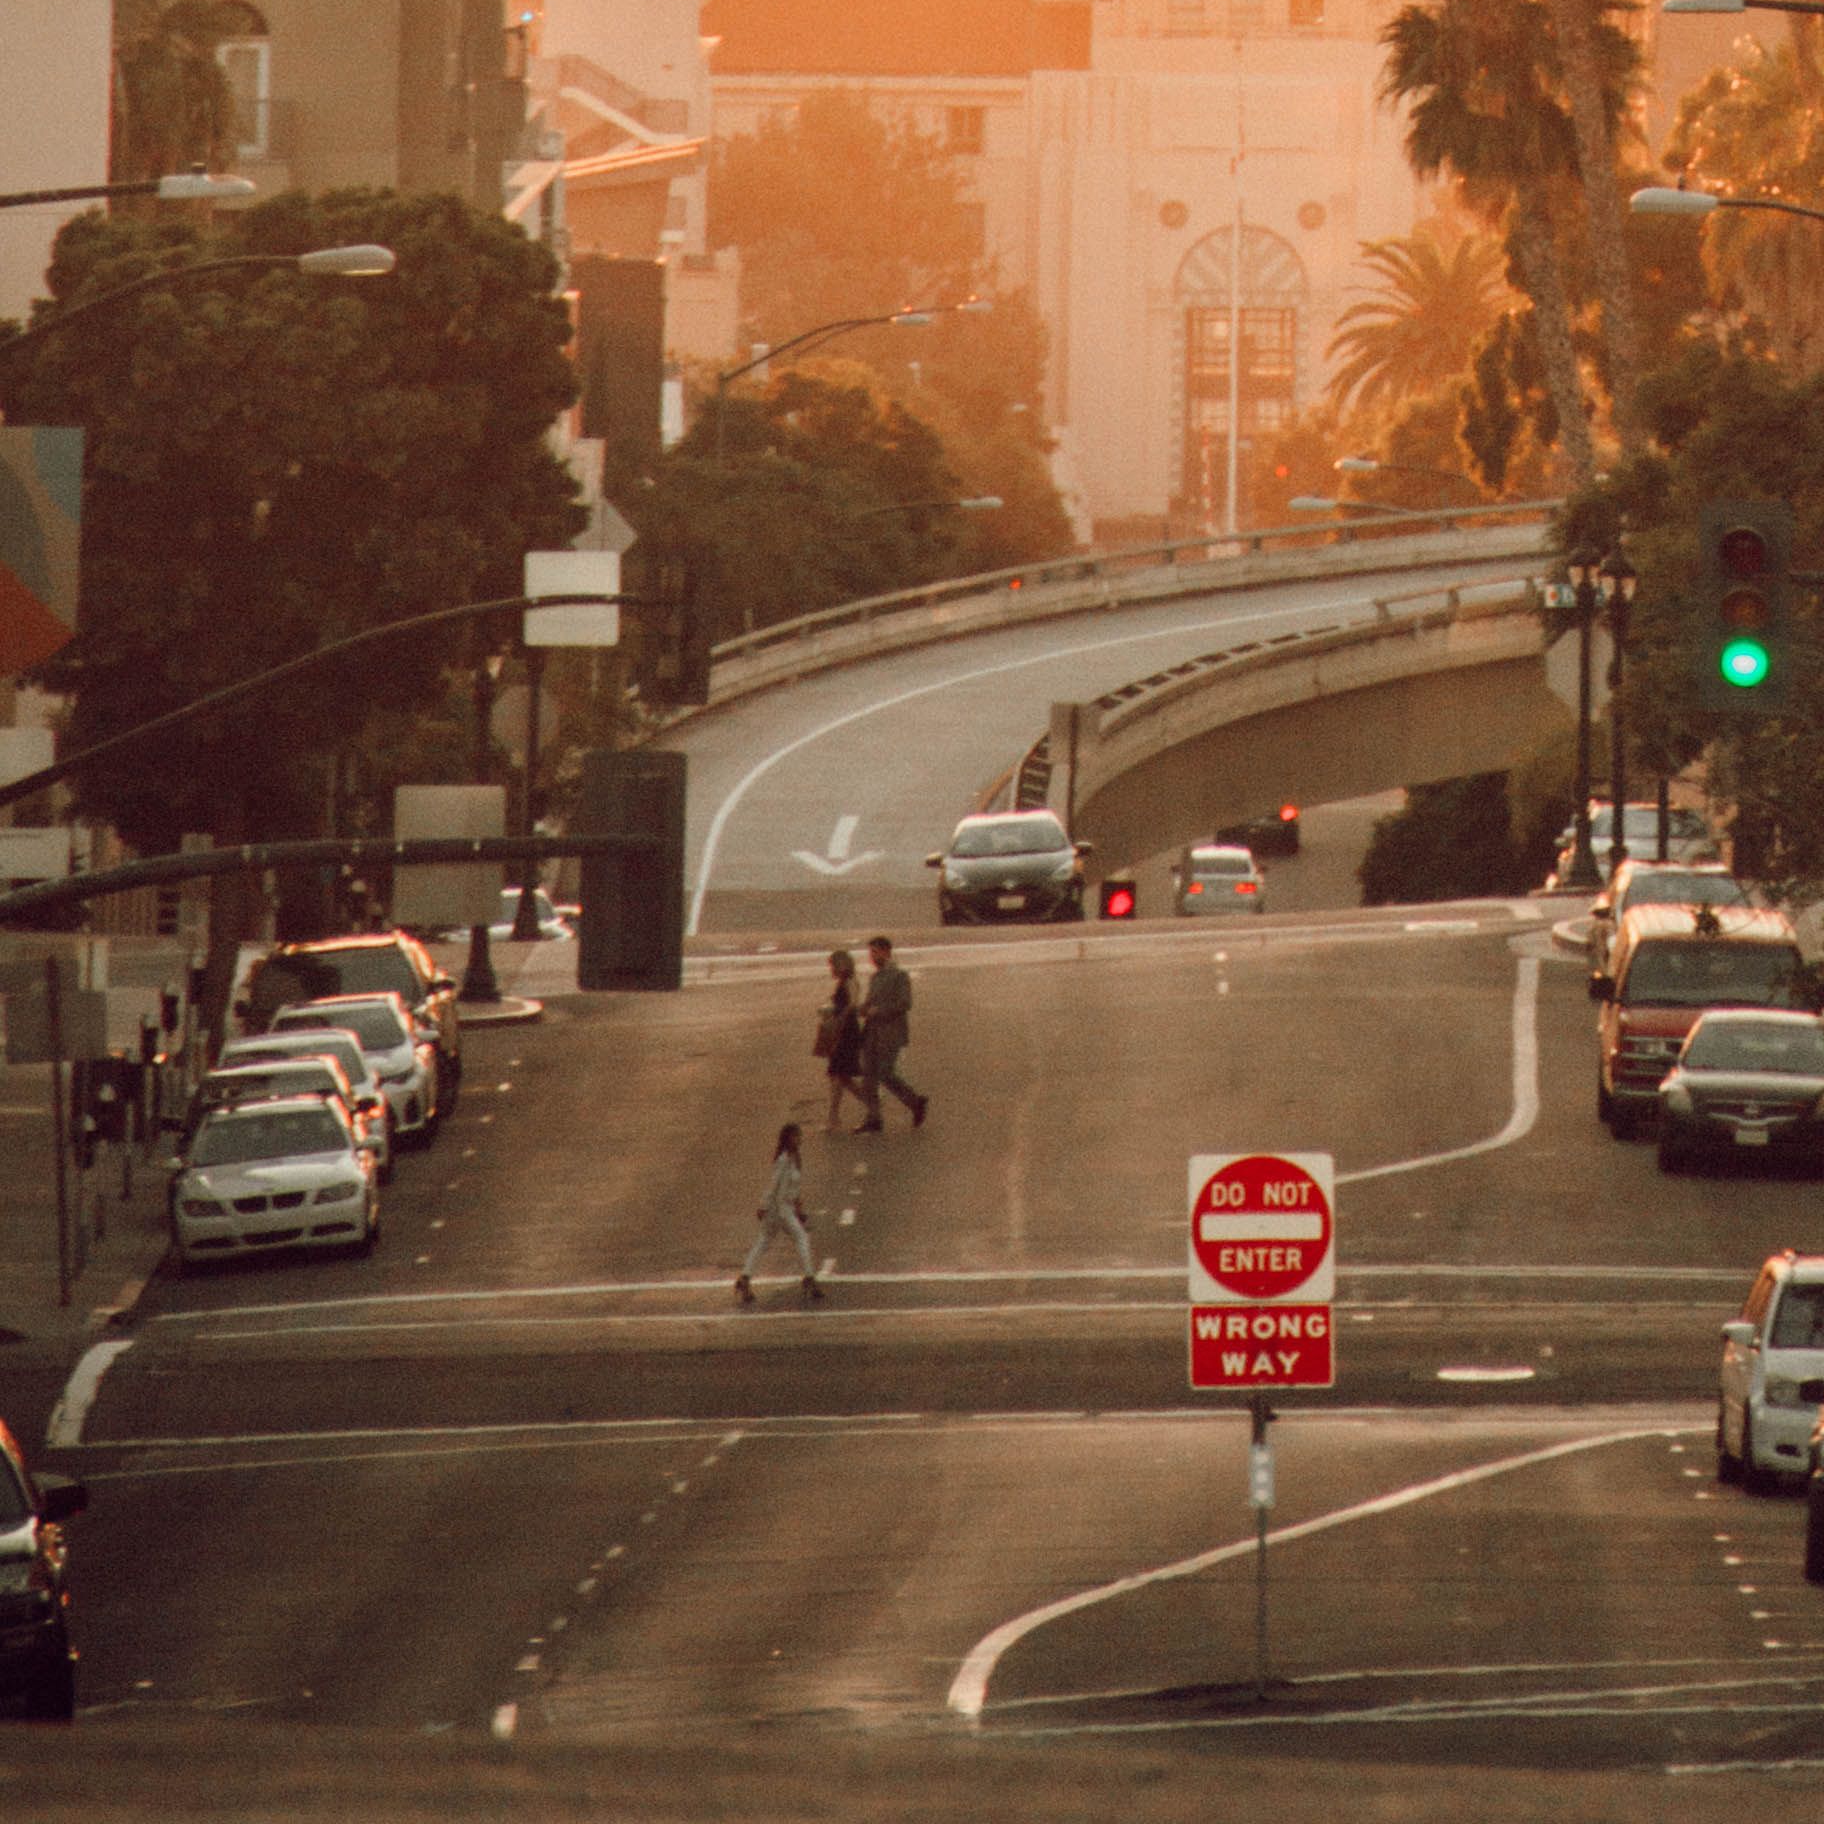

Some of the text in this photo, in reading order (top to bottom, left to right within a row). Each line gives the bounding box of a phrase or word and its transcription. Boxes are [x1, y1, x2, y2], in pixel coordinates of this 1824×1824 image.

[1210, 1182, 1312, 1207] DO NOT
[1219, 1248, 1302, 1272] ENTER
[1196, 1315, 1326, 1339] WRONG
[1221, 1352, 1300, 1375] WAY
